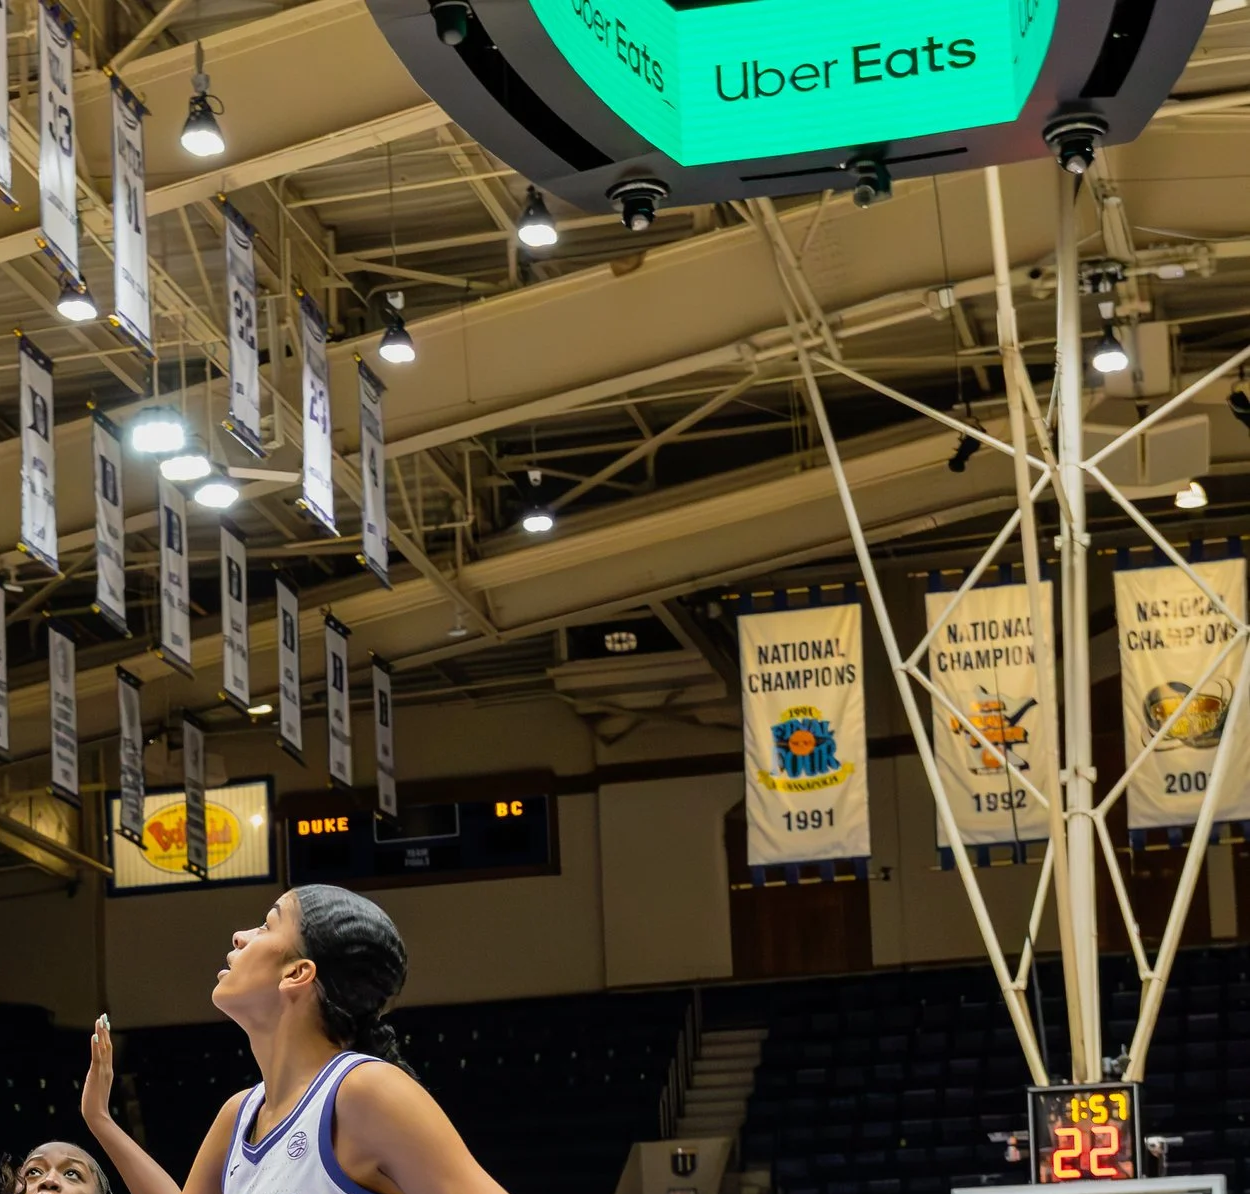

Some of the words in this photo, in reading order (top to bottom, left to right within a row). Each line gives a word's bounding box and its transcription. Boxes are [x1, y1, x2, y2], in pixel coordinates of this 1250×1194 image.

[615, 17, 664, 93] Eats
[715, 60, 838, 102] Uber
[852, 35, 977, 85] Eats
[947, 617, 1034, 644] NATIONAL
[758, 637, 846, 666] NATIONAL
[937, 646, 1035, 672] CHAMPION
[748, 663, 856, 693] CHAMPIONS
[1165, 771, 1211, 794] 200
[495, 801, 523, 817] BC
[973, 789, 1027, 812] 1992
[298, 817, 349, 836] DUKE
[783, 808, 834, 831] 1991
[1071, 1093, 1127, 1124] 1:57
[1053, 1126, 1119, 1178] 22
